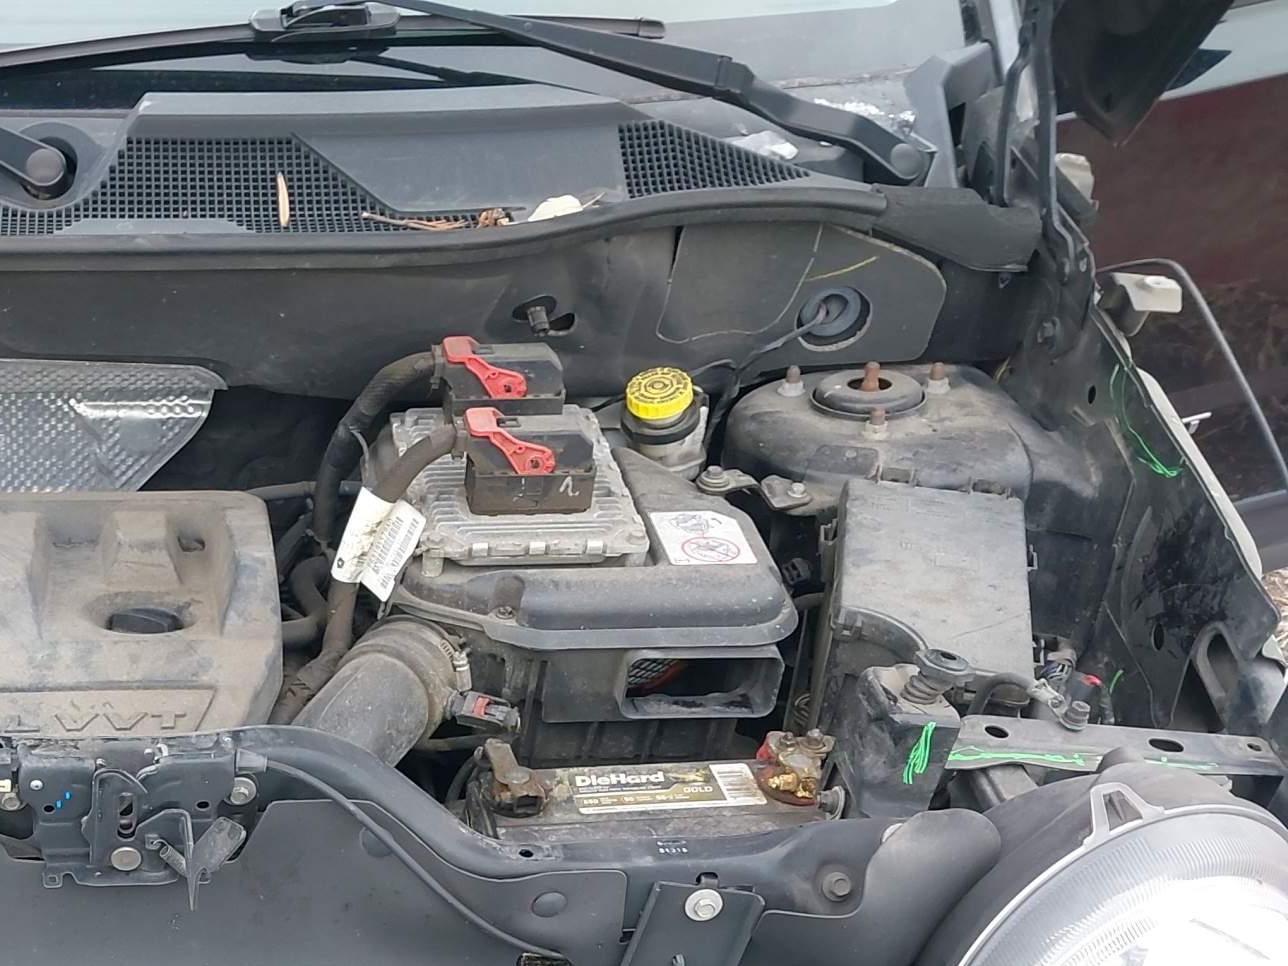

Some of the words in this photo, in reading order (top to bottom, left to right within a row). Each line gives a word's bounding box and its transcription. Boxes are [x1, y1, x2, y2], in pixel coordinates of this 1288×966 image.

[54, 712, 187, 732] VVT
[574, 770, 665, 787] DieHard
[683, 785, 713, 794] GOLD
